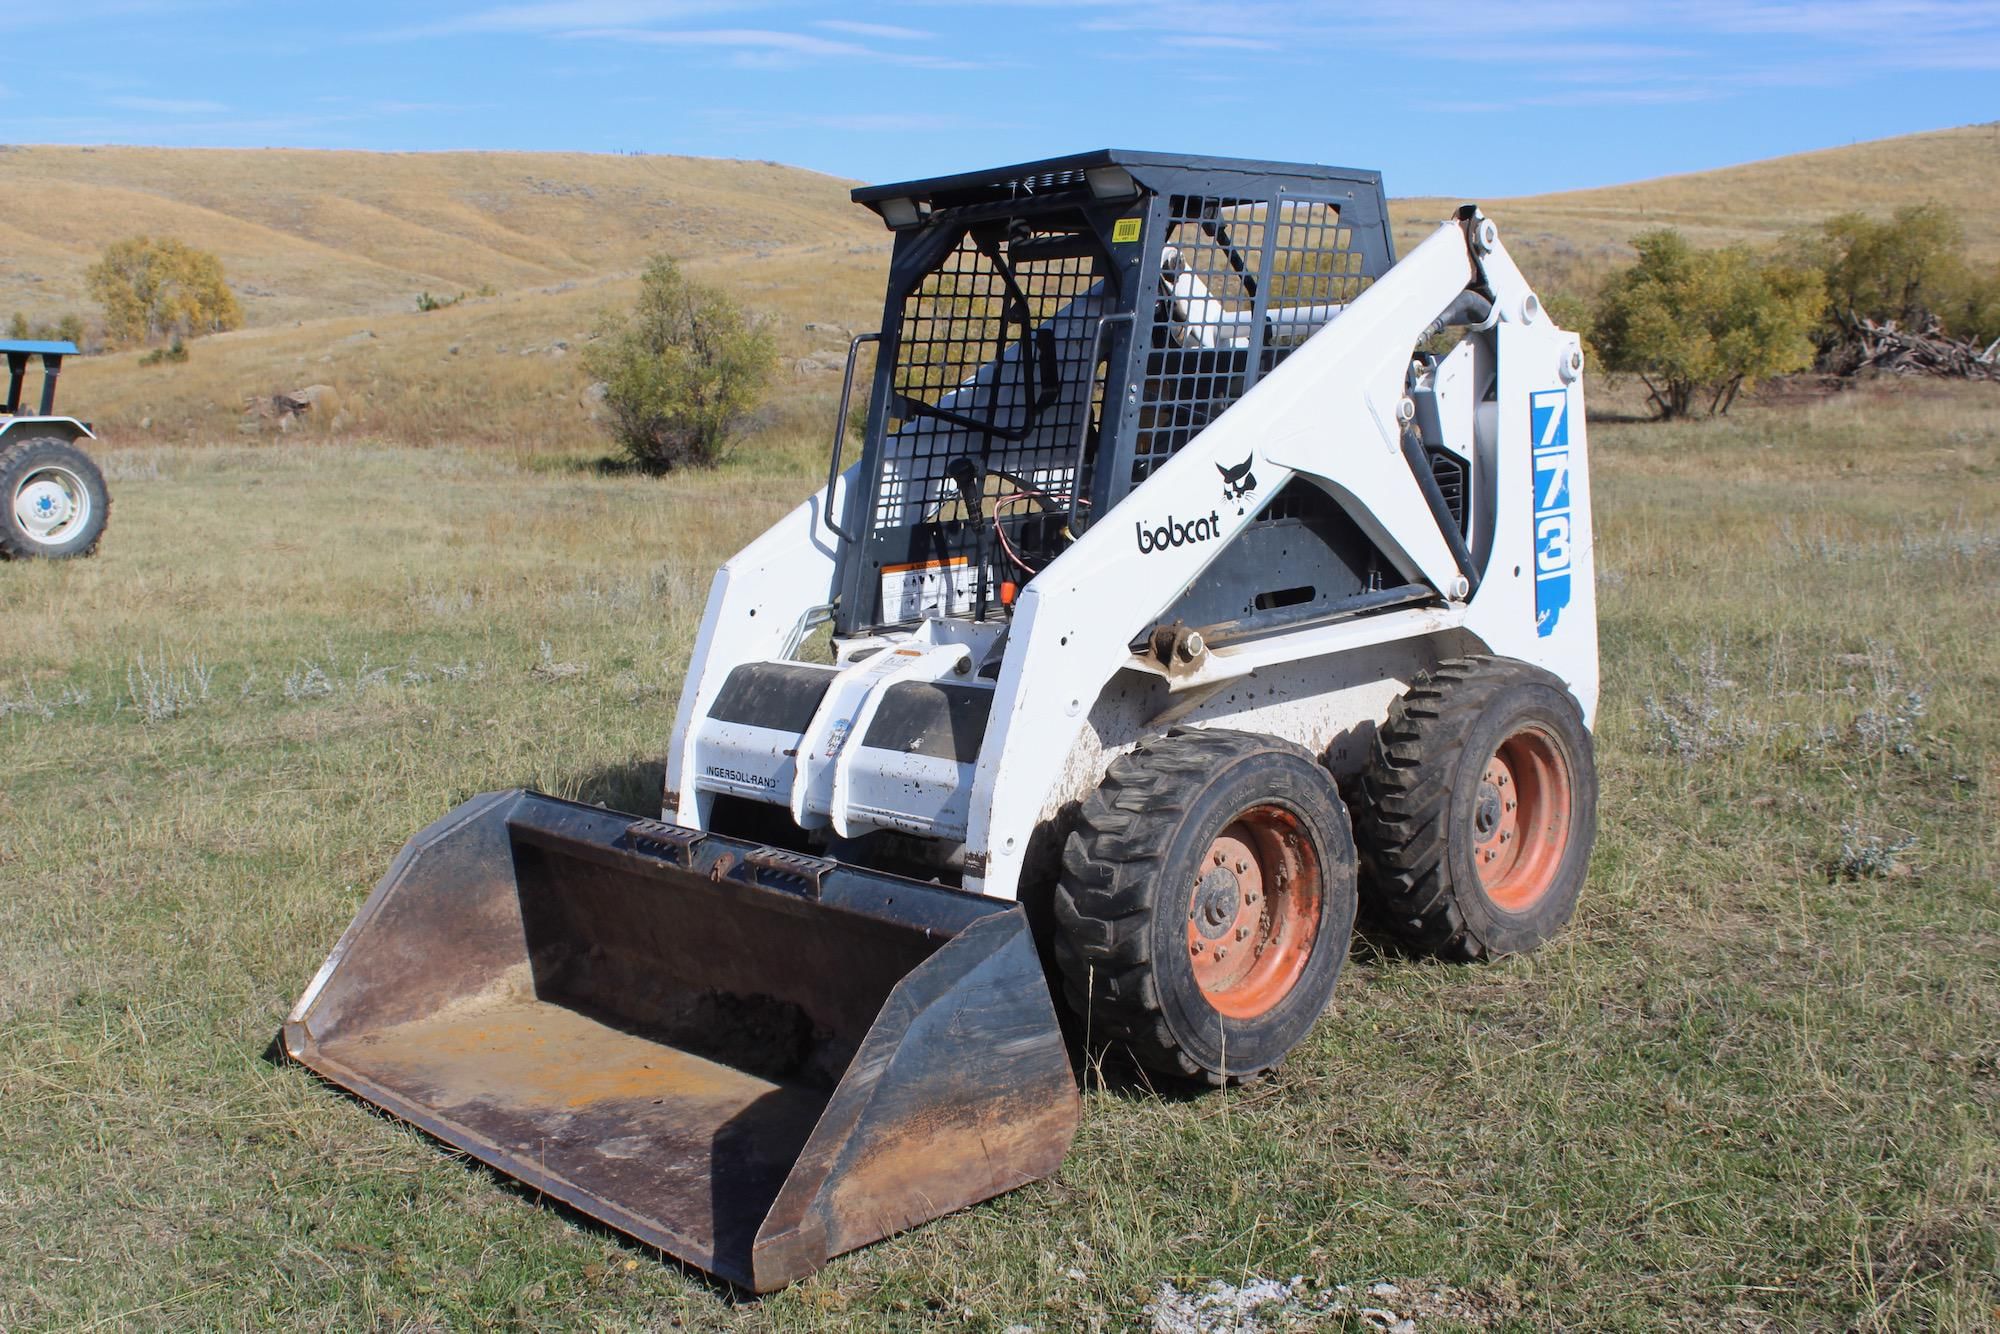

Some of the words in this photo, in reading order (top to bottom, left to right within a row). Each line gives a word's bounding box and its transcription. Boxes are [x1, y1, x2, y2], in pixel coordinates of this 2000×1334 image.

[1534, 390, 1571, 573] 773
[1136, 509, 1220, 555] bobcat
[706, 765, 777, 788] INGERSOLL-RAND
